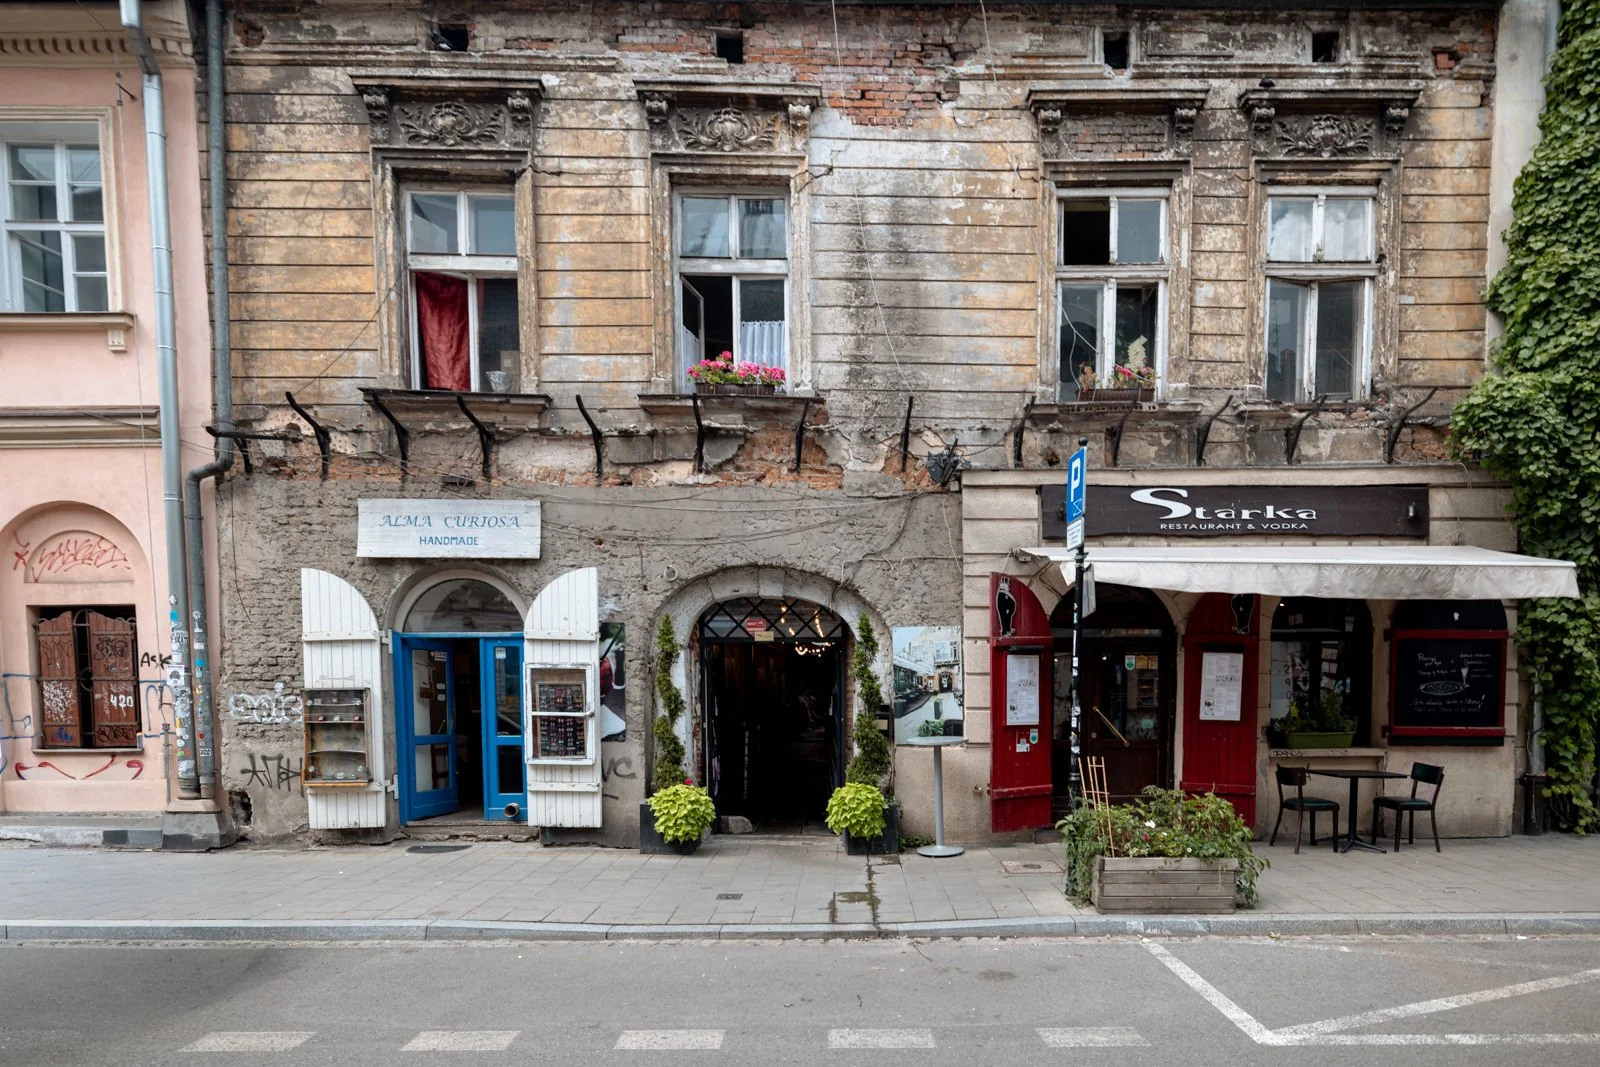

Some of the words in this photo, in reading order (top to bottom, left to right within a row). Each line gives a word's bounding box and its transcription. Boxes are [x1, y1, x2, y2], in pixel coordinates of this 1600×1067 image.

[1070, 457, 1081, 503] P
[1130, 487, 1317, 520] Starka
[379, 515, 433, 528] ALMA
[444, 515, 521, 529] CURIOSA
[1160, 523, 1242, 531] RESTAURANT
[1247, 523, 1256, 531] &
[1261, 523, 1309, 531] VODKA
[419, 536, 480, 546] HANDMADE
[110, 695, 134, 712] 420
